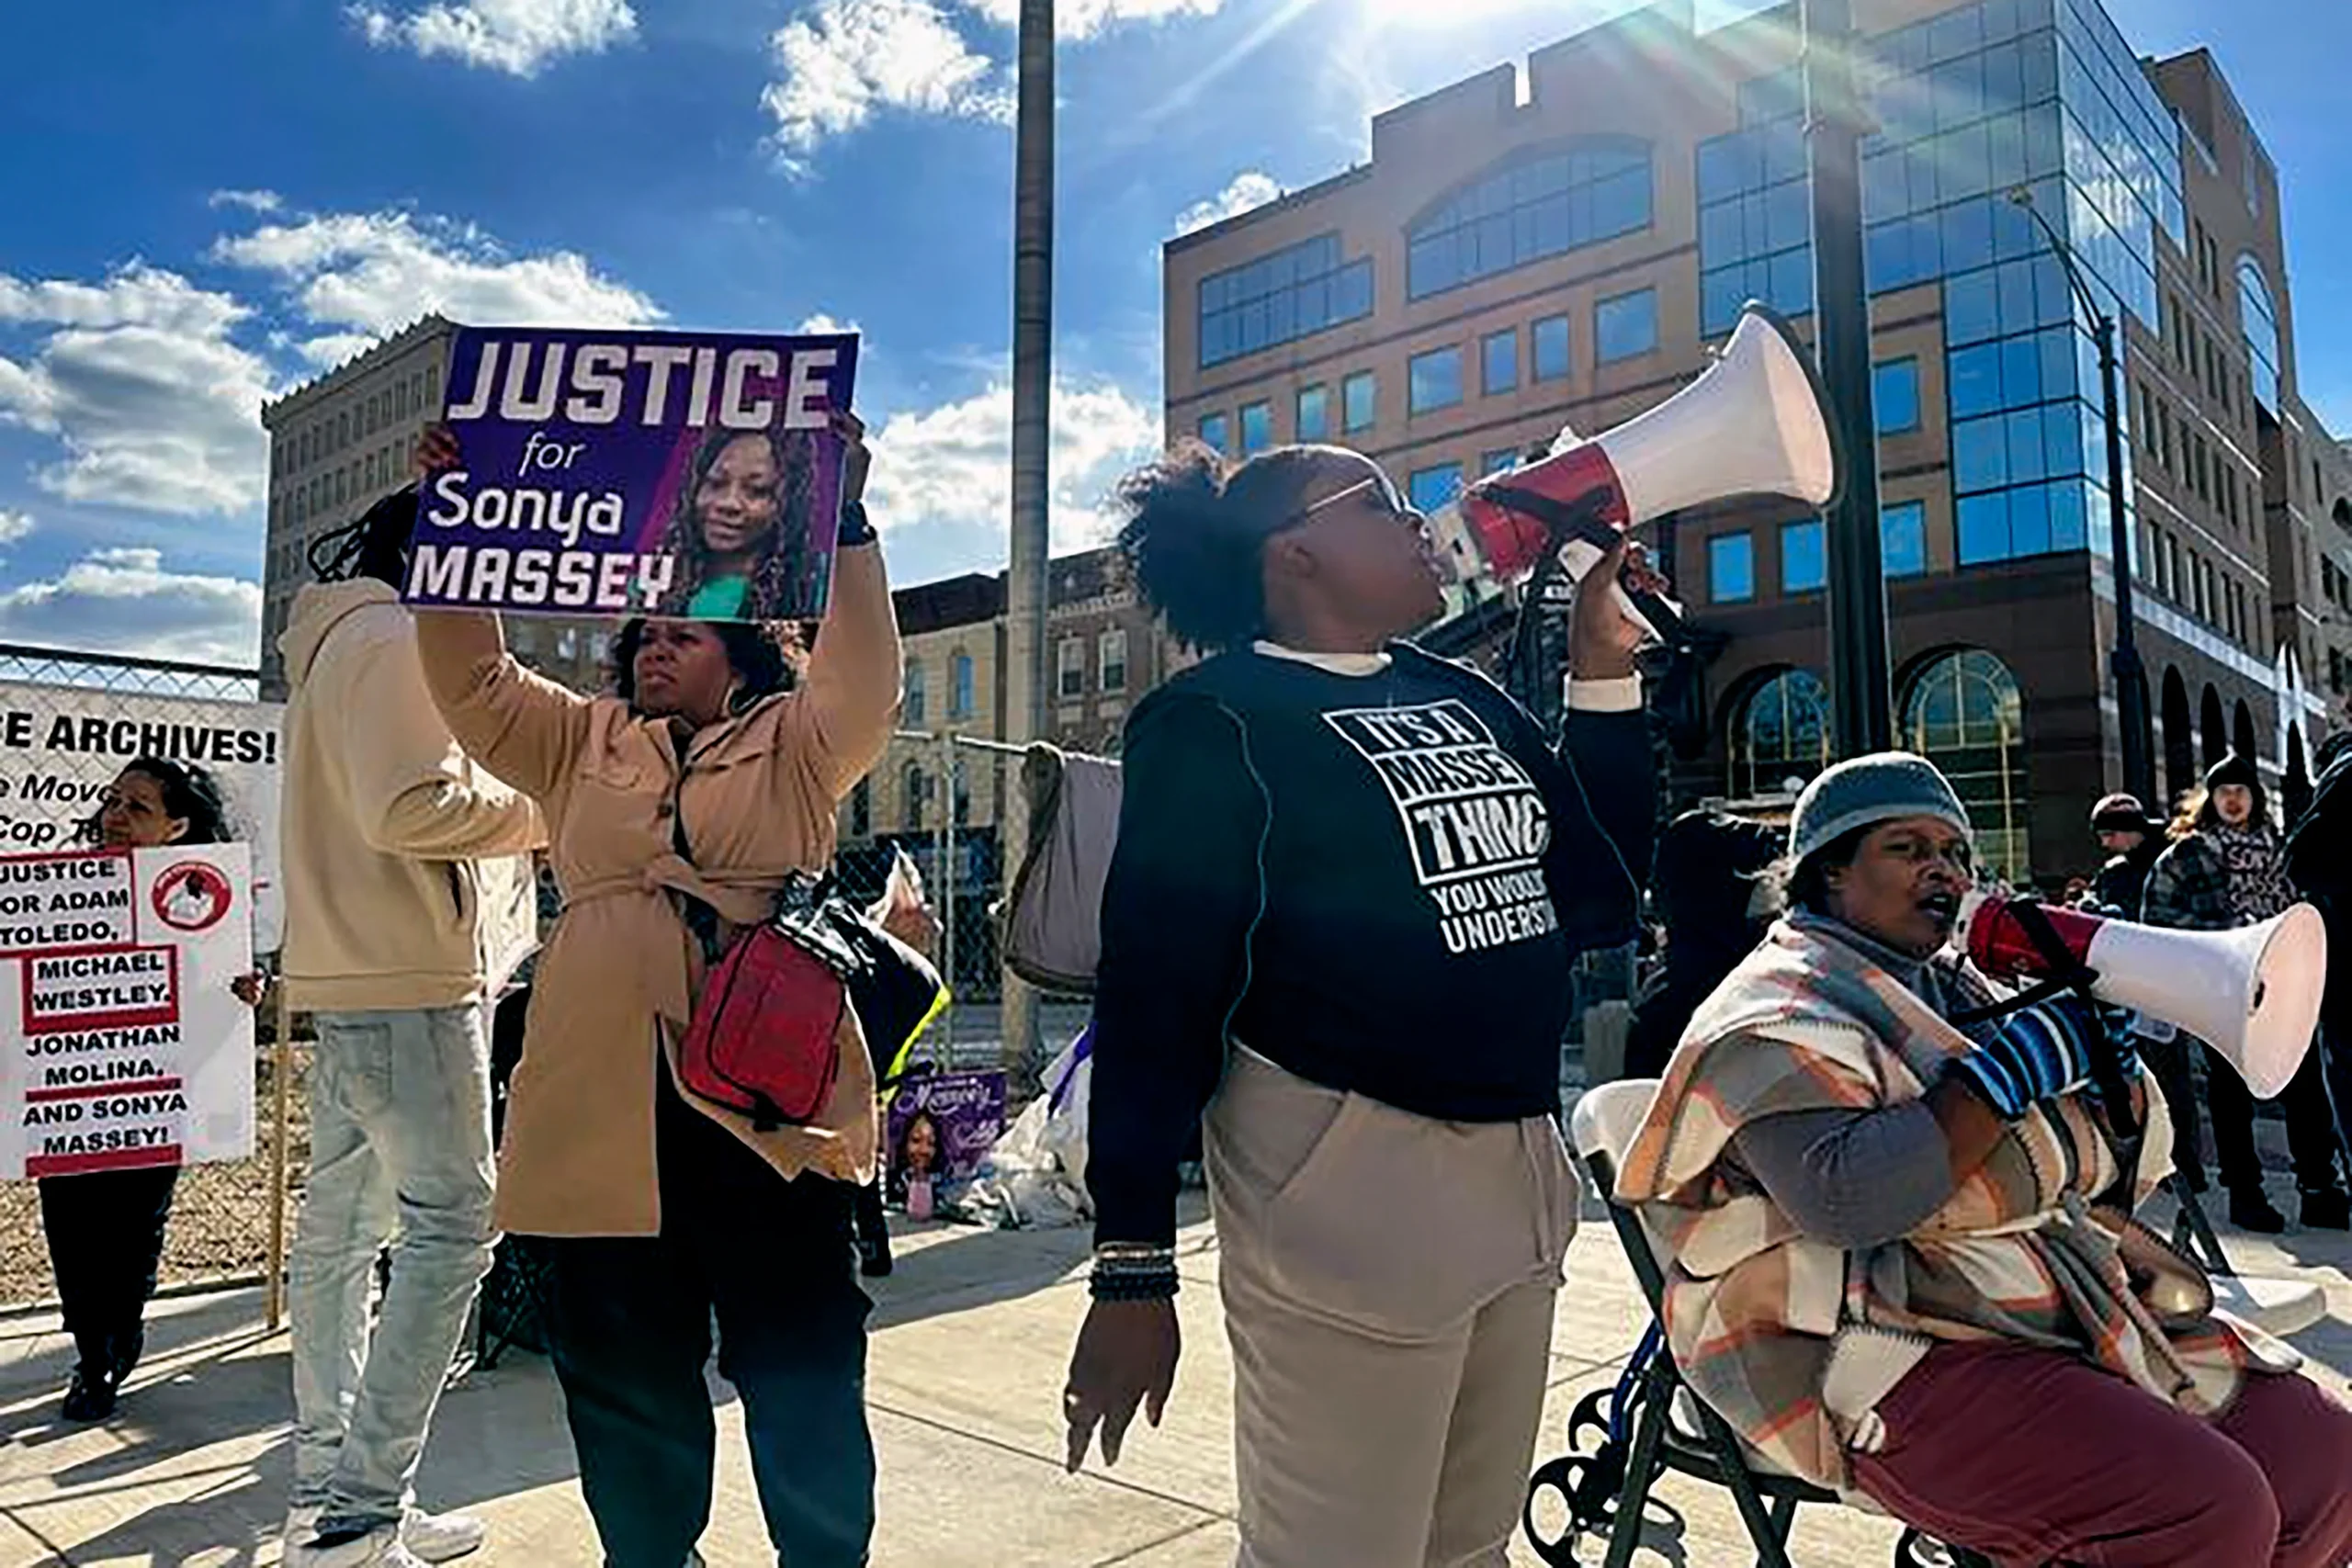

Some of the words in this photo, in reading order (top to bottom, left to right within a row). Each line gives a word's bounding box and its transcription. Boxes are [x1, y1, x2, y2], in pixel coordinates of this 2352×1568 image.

[447, 342, 838, 429] JUSTICE
[519, 432, 585, 476] for
[427, 471, 623, 548] Sonya
[406, 545, 674, 610] MASSEY
[46, 715, 277, 764] ARCHIVES!
[1429, 708, 1476, 743] A
[1376, 749, 1531, 801] MASSE
[1413, 794, 1550, 871] THING
[0, 860, 117, 884] JUSTICE
[0, 895, 40, 915] OR
[49, 889, 129, 912] ADAM
[1430, 879, 1488, 917] YOU
[38, 953, 164, 979] MICHAEL
[26, 1025, 179, 1056] JONATHAN
[23, 1103, 83, 1127] AND
[93, 1093, 187, 1120] SONYA
[43, 1126, 168, 1155] MASSEY!
